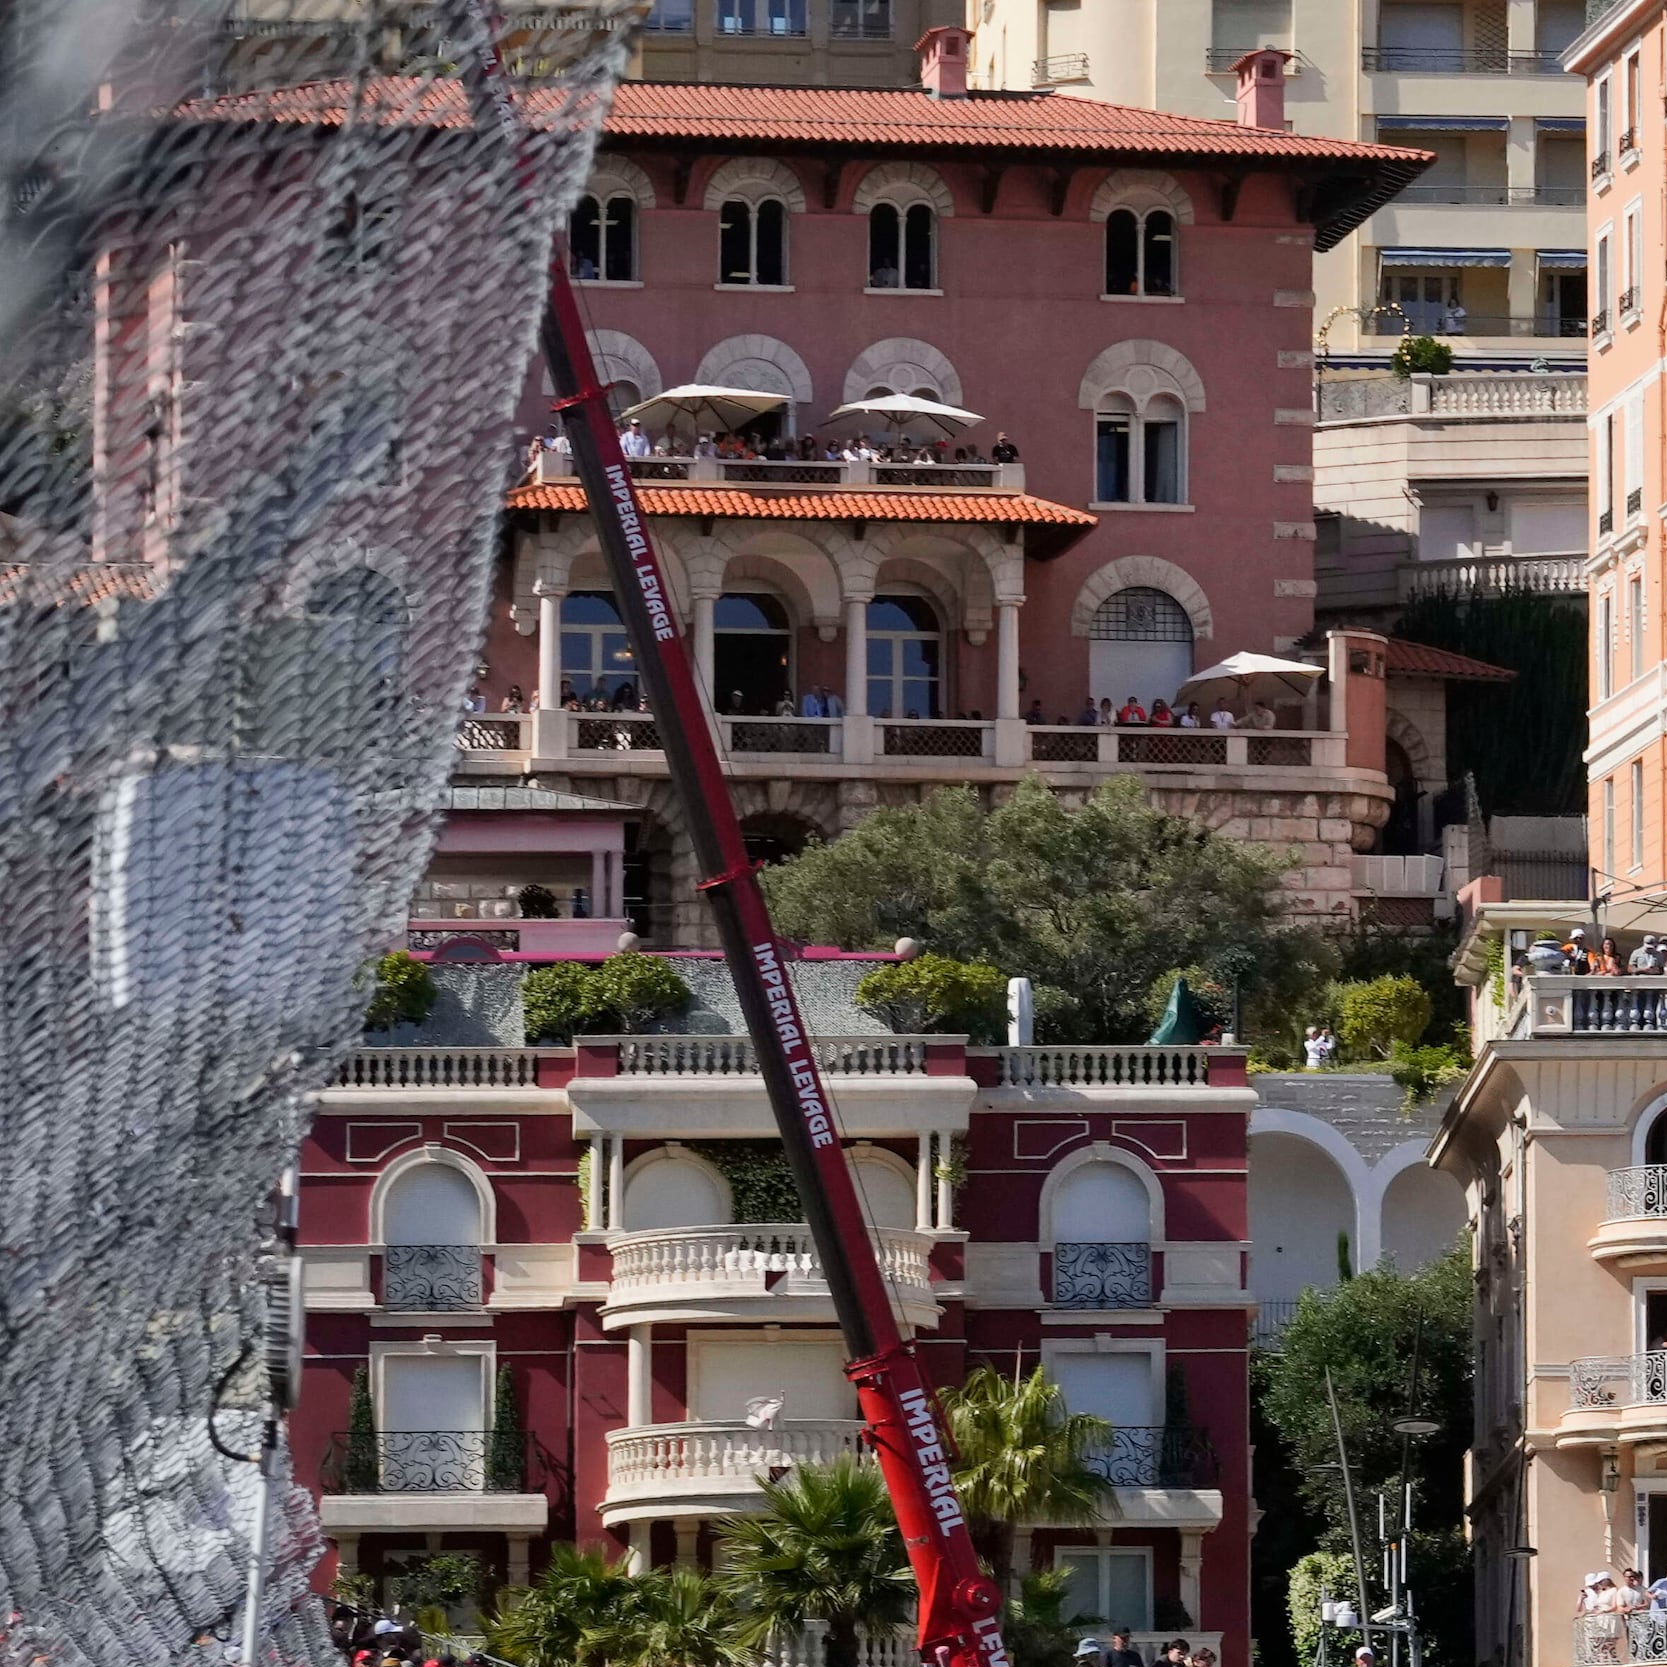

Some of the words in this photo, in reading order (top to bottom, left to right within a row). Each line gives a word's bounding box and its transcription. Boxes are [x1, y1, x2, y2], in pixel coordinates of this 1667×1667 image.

[605, 464, 648, 561] IMPERIAL
[635, 564, 674, 642] LEVAGE
[753, 942, 802, 1055] IMPERIAL
[789, 1059, 833, 1149] LEVAGE
[900, 1388, 964, 1537] IMPERIAL
